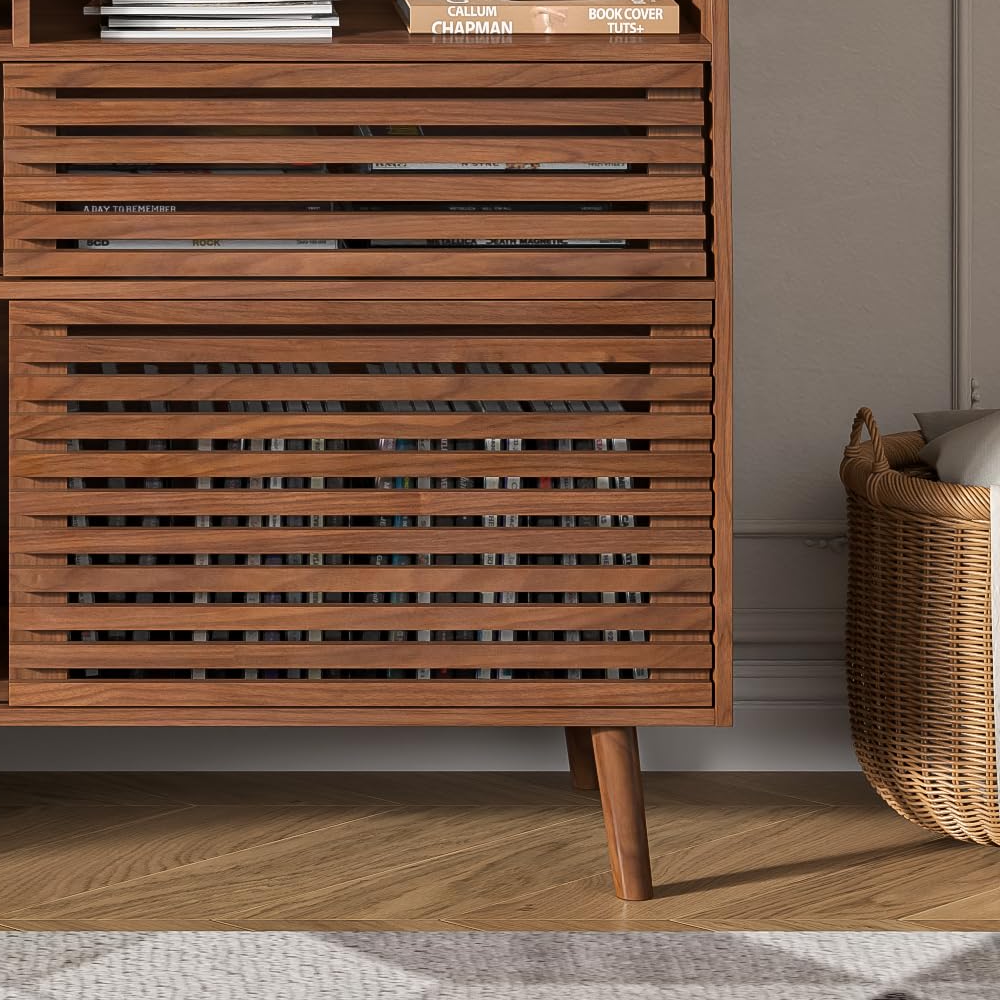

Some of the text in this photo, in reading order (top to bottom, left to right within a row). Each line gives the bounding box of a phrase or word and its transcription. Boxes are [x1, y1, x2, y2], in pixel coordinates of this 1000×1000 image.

[447, 6, 497, 16] CALLUM
[588, 8, 663, 20] BOOK COVER
[431, 20, 513, 34] CHAPMAN
[607, 22, 644, 34] TUTS+
